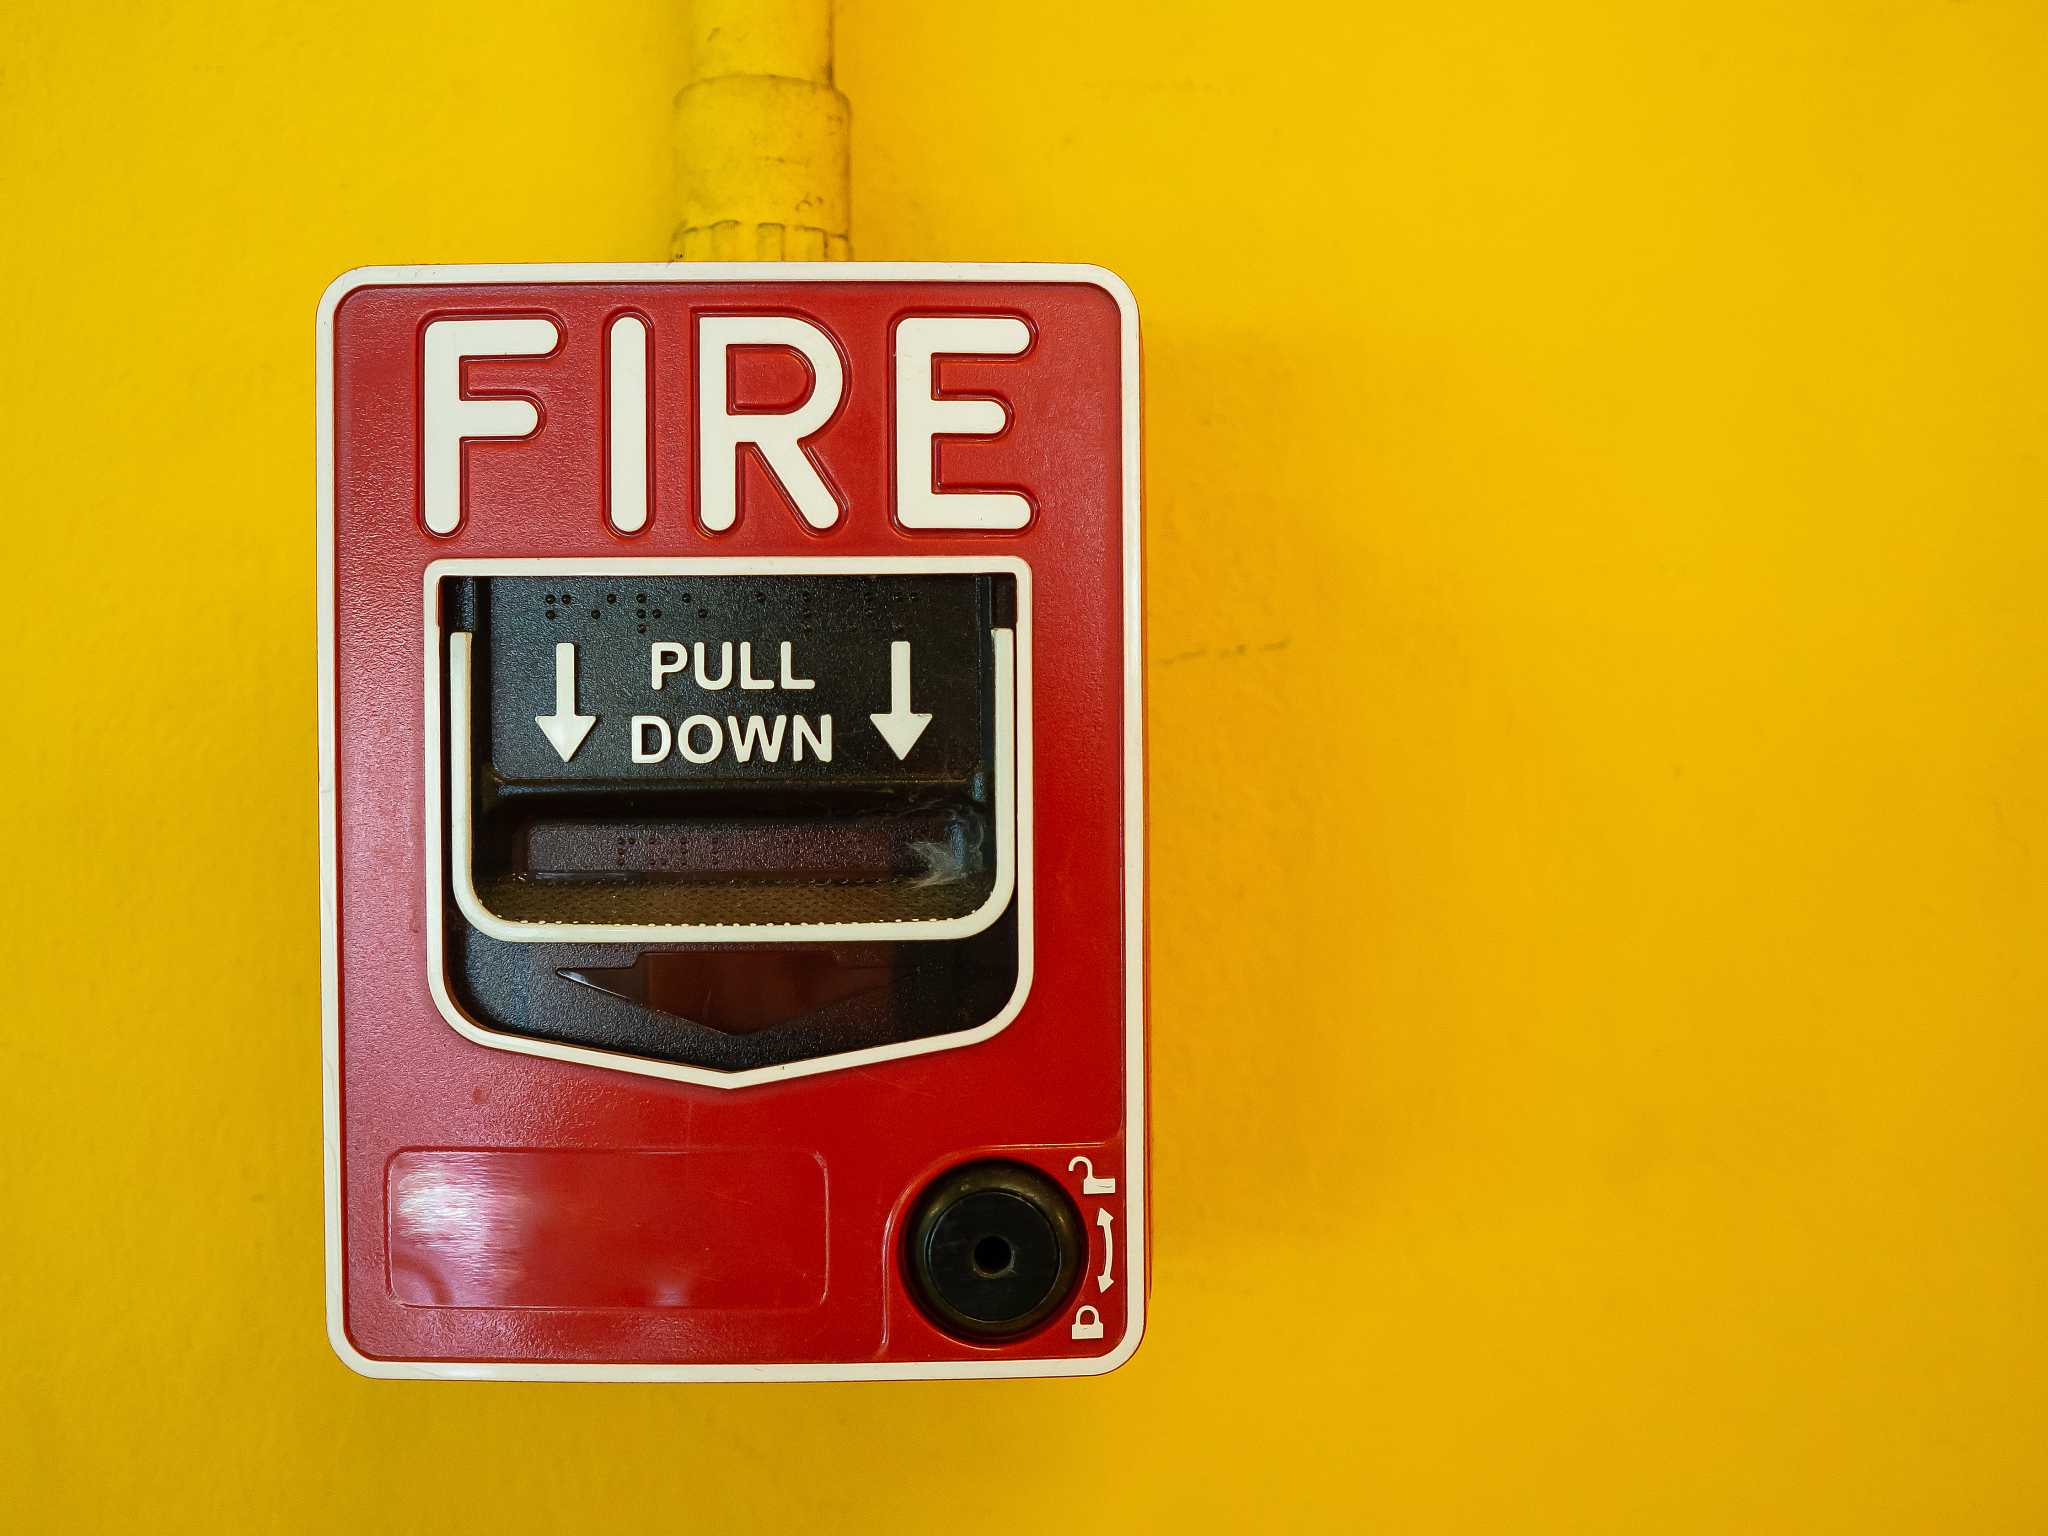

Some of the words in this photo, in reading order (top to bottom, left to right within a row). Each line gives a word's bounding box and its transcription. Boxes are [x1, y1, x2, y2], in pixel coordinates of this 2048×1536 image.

[424, 316, 1031, 534] FIRE
[650, 641, 816, 691] PULL
[630, 714, 832, 764] DOWN
